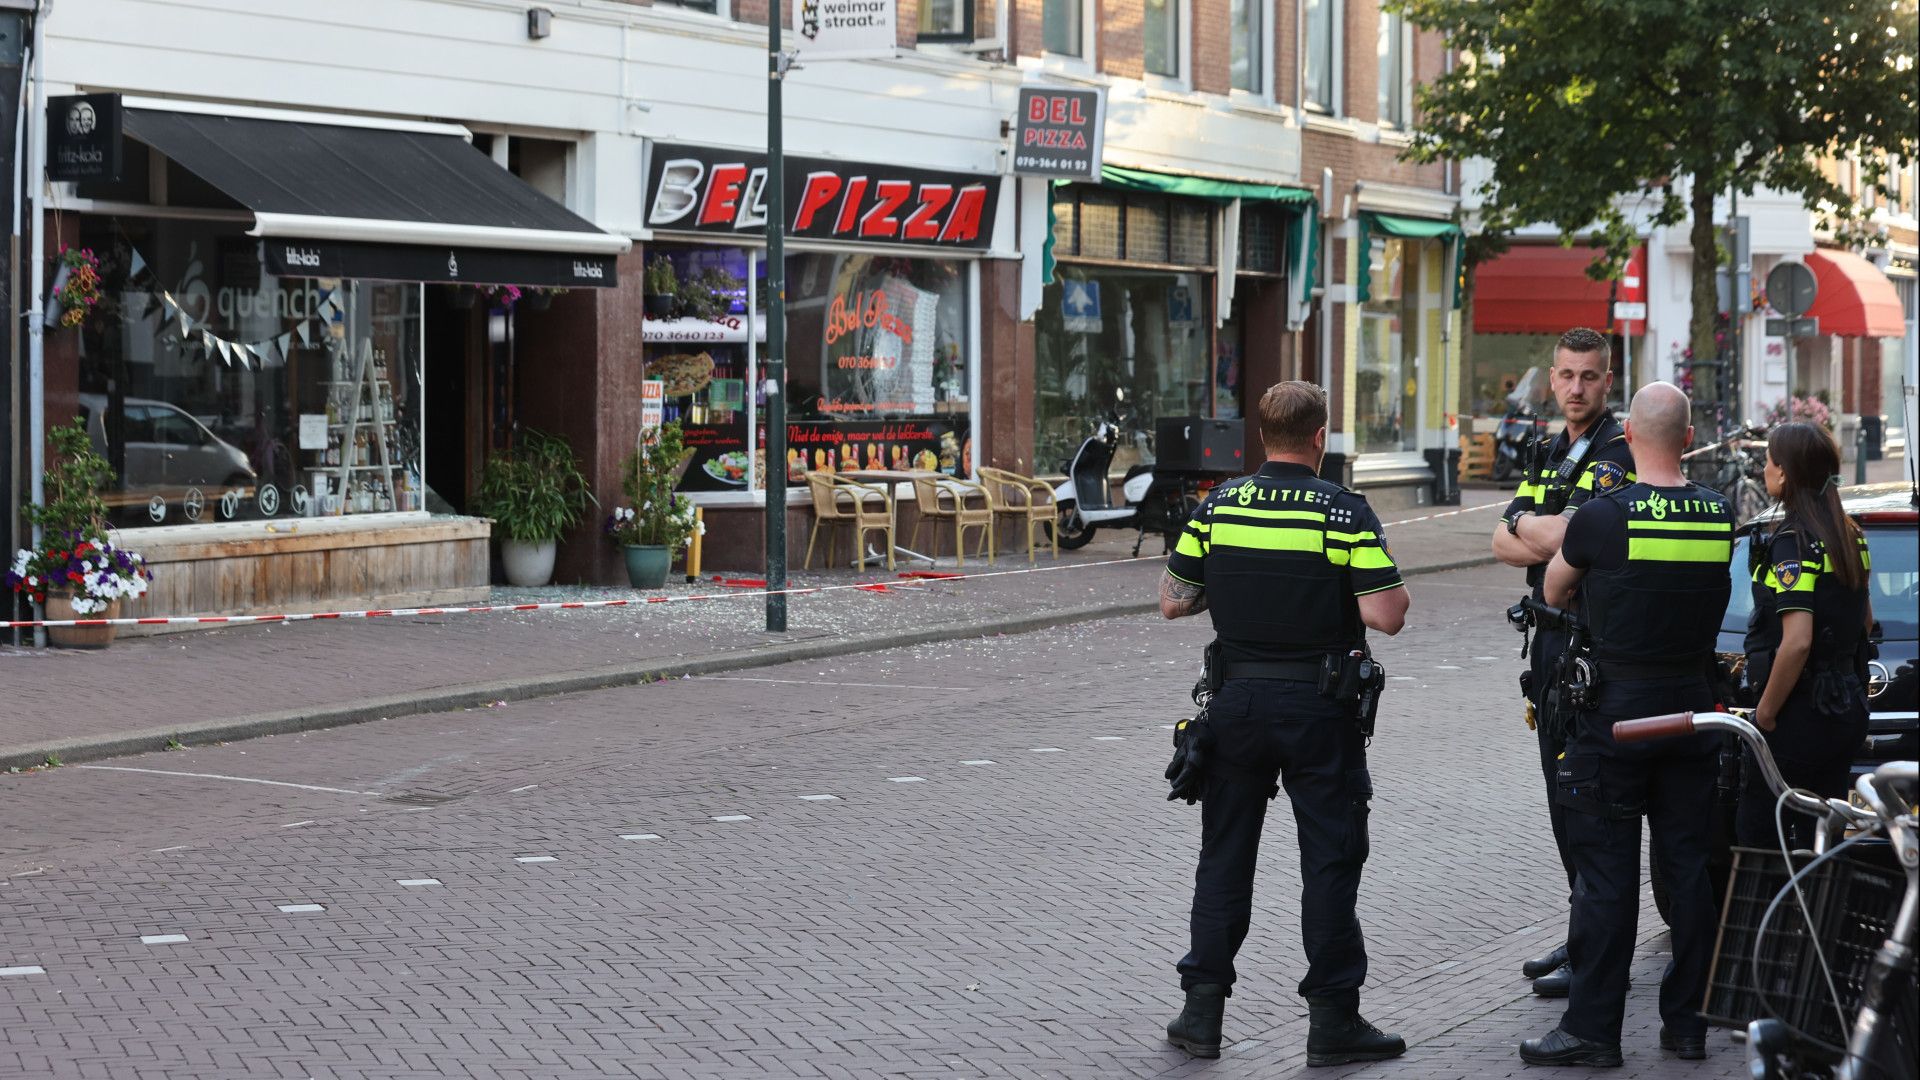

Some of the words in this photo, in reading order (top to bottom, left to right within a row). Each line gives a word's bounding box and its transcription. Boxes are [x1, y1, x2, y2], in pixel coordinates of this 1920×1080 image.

[824, 0, 886, 13] weimar
[1028, 95, 1087, 125] BEL
[1023, 127, 1087, 150] PIZZA
[1016, 156, 1057, 169] 070-364
[1060, 158, 1072, 170] 01
[649, 158, 768, 228] BEL
[792, 170, 987, 242] PIZZA
[217, 278, 321, 330] quench
[826, 292, 863, 344] Bel
[667, 331, 700, 341] 3640
[704, 331, 724, 341] 123
[838, 355, 856, 369] 070
[642, 383, 661, 398] IZZA
[788, 425, 809, 442] Niet
[810, 426, 821, 441] de
[847, 431, 870, 442] maar
[872, 424, 886, 441] wel
[886, 425, 896, 441] de
[1227, 482, 1316, 505] POLITIE
[1636, 494, 1720, 518] POLITIE
